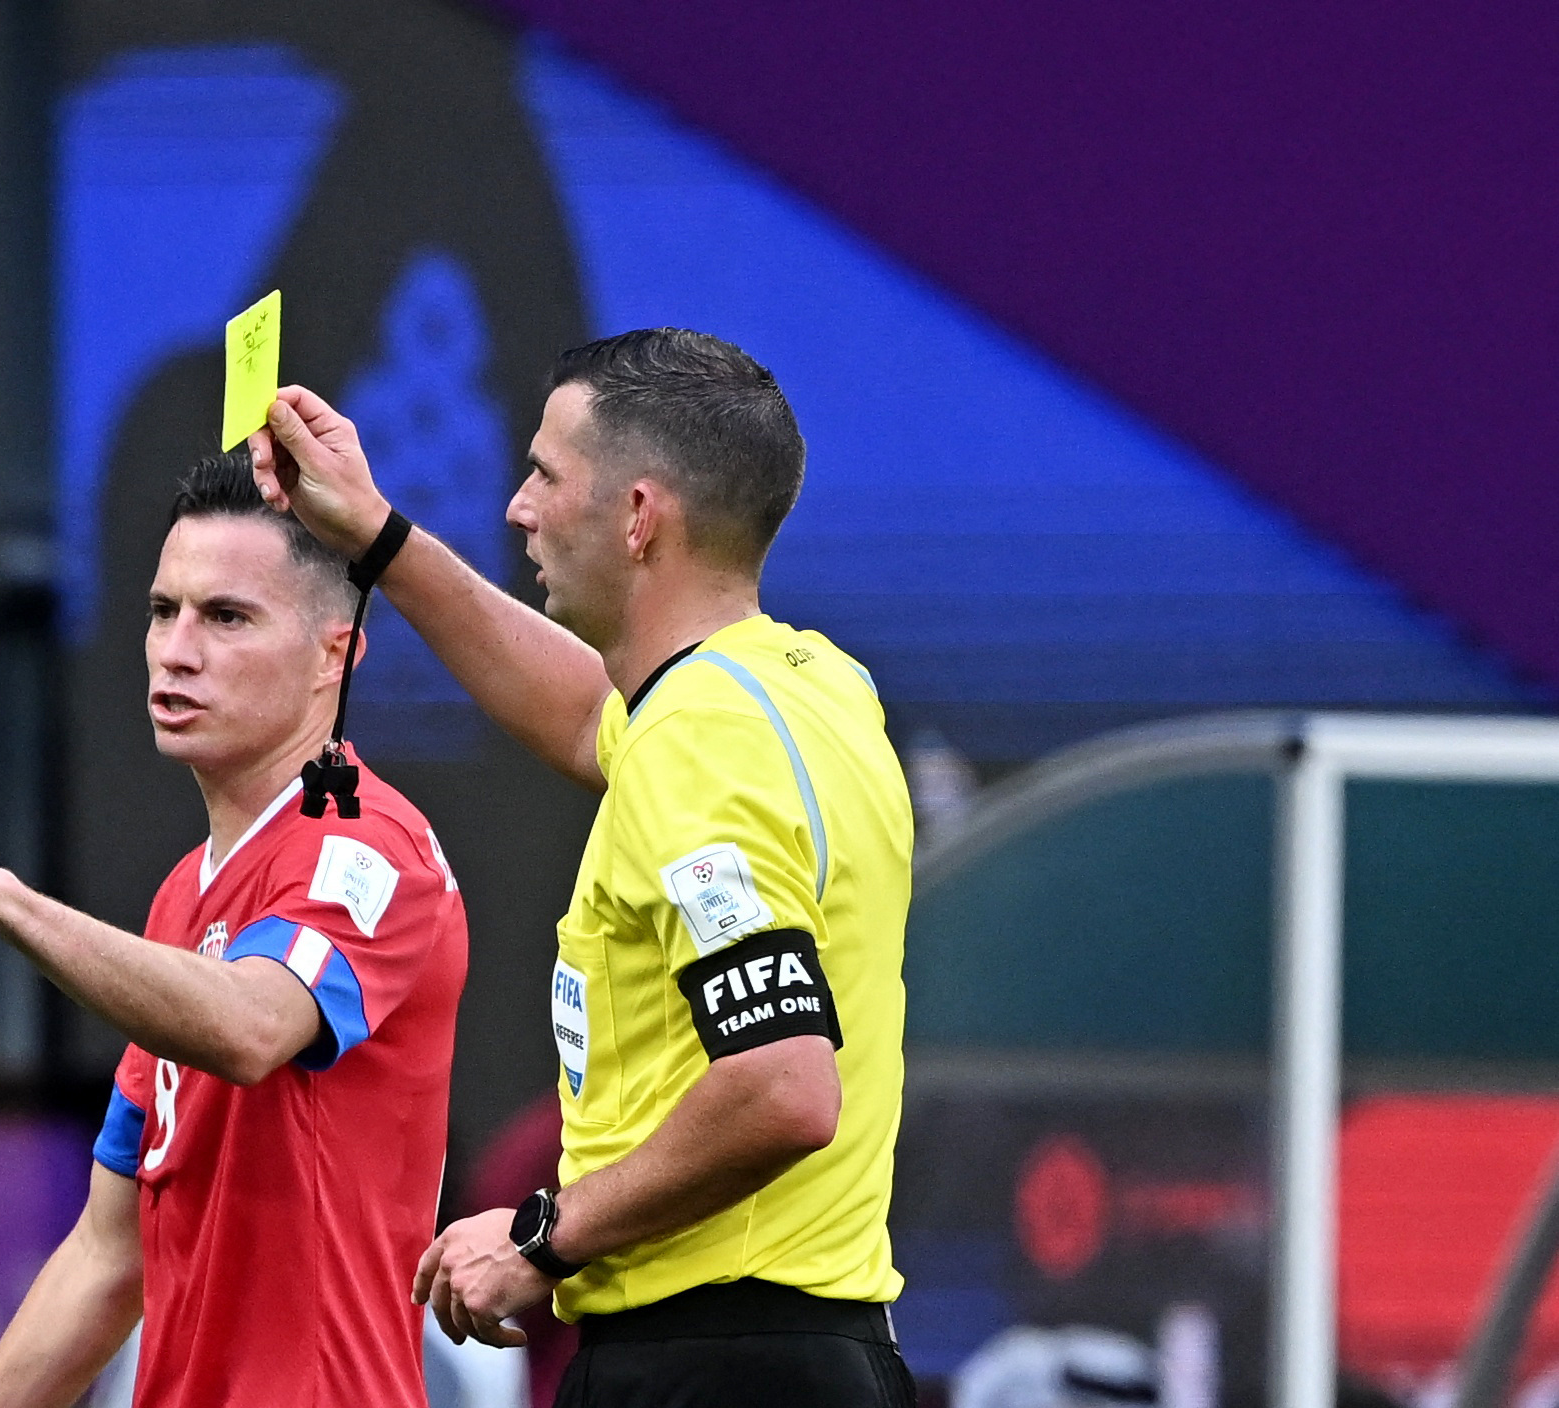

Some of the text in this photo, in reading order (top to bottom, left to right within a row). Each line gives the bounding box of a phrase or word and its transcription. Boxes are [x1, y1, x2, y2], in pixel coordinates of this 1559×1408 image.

[555, 969, 583, 1013] FIFA
[702, 952, 814, 1015] FIFA
[555, 1022, 584, 1050] REFEREE
[717, 996, 821, 1037] TEAM ONE
